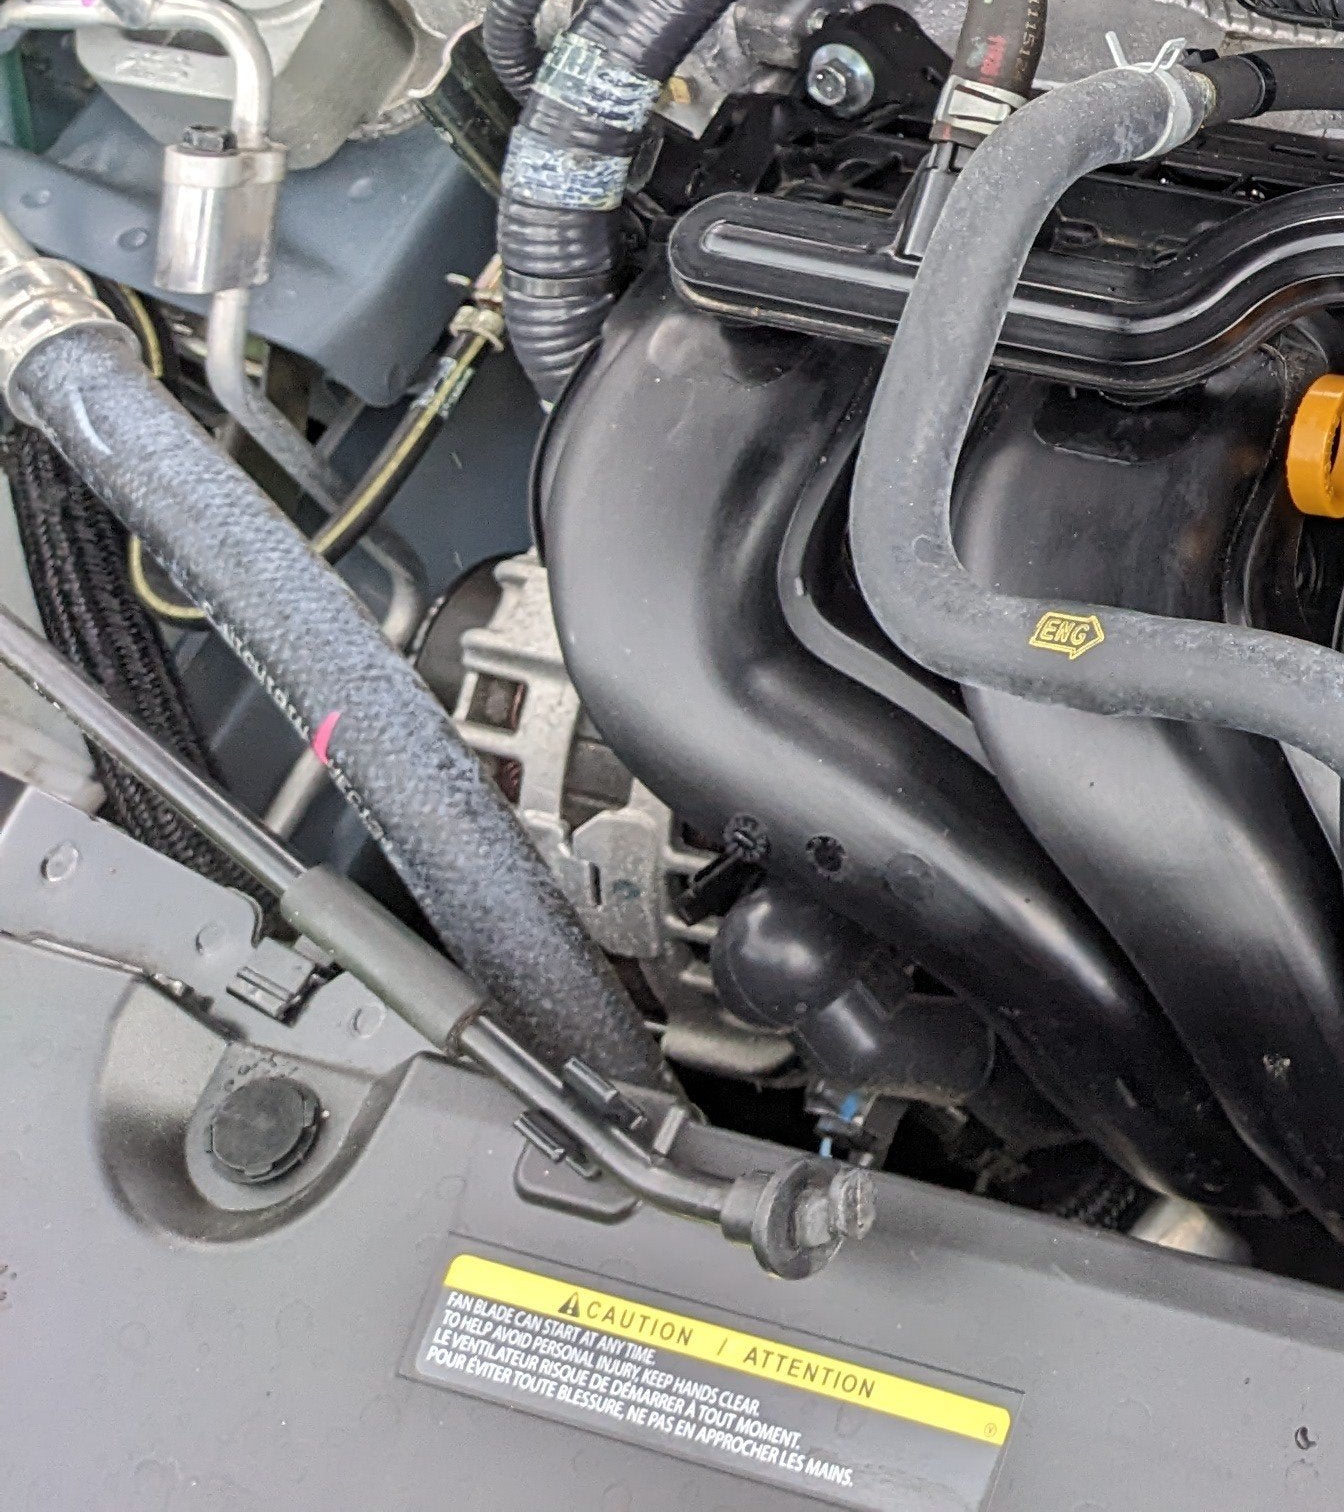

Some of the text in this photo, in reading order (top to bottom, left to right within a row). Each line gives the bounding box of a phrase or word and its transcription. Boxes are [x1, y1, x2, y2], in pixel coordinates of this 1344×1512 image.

[1039, 618, 1090, 646] ENG
[442, 1310, 461, 1327] TO
[460, 1315, 493, 1339] HELP
[492, 1325, 534, 1351] AVOID
[533, 1336, 597, 1369] PERSONAL
[640, 1365, 675, 1392] KEEP
[671, 1376, 719, 1405] HANDS
[717, 1390, 761, 1418] CLEAR.
[446, 1291, 658, 1366] FAN BLADE CAN START AT ANY TIME.
[586, 1301, 694, 1346] CAUTION
[743, 1346, 876, 1399] ATTENTION
[426, 1345, 855, 1489] POUR ÉVITER TOUTE BLESSURE, NE PAS EN APPROCHER LES MAINS.
[433, 1327, 452, 1345] LE
[451, 1332, 540, 1370] VENTILATEUR
[539, 1360, 589, 1387] RISQUE
[588, 1373, 610, 1393] DE
[609, 1376, 687, 1414] DÉMARRER
[696, 1402, 737, 1429] TOUT
[736, 1416, 803, 1450] MOMENT.
